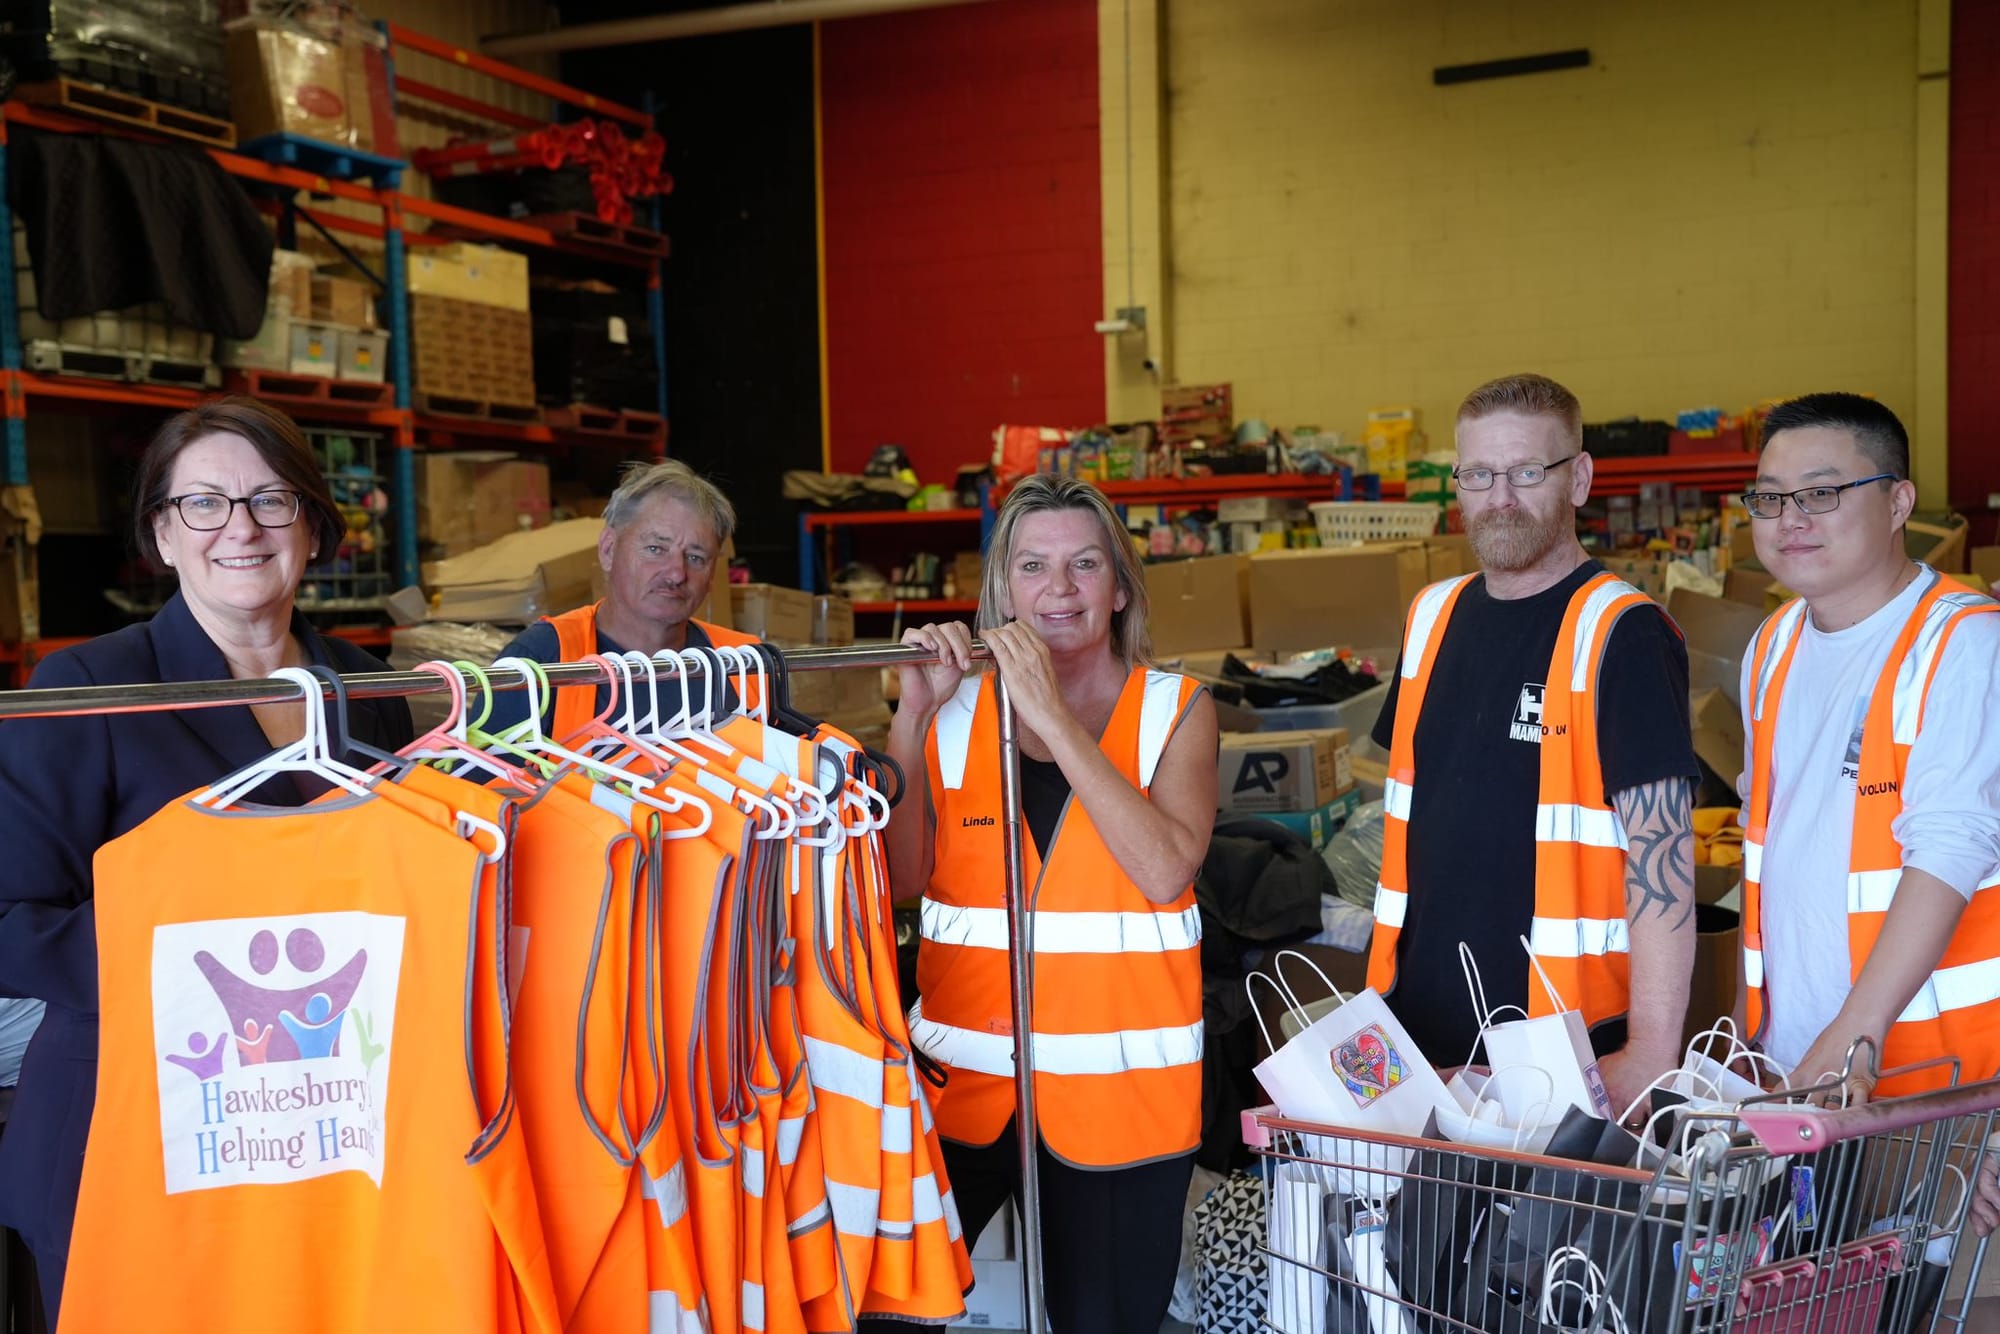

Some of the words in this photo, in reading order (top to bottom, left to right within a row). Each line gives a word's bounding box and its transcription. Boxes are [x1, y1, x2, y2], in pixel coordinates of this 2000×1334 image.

[1232, 751, 1289, 793] AP
[1859, 781, 1898, 797] VOLUN
[962, 816, 995, 827] Linda
[200, 1072, 368, 1125] Hawkesbury
[196, 1126, 306, 1172] Helping
